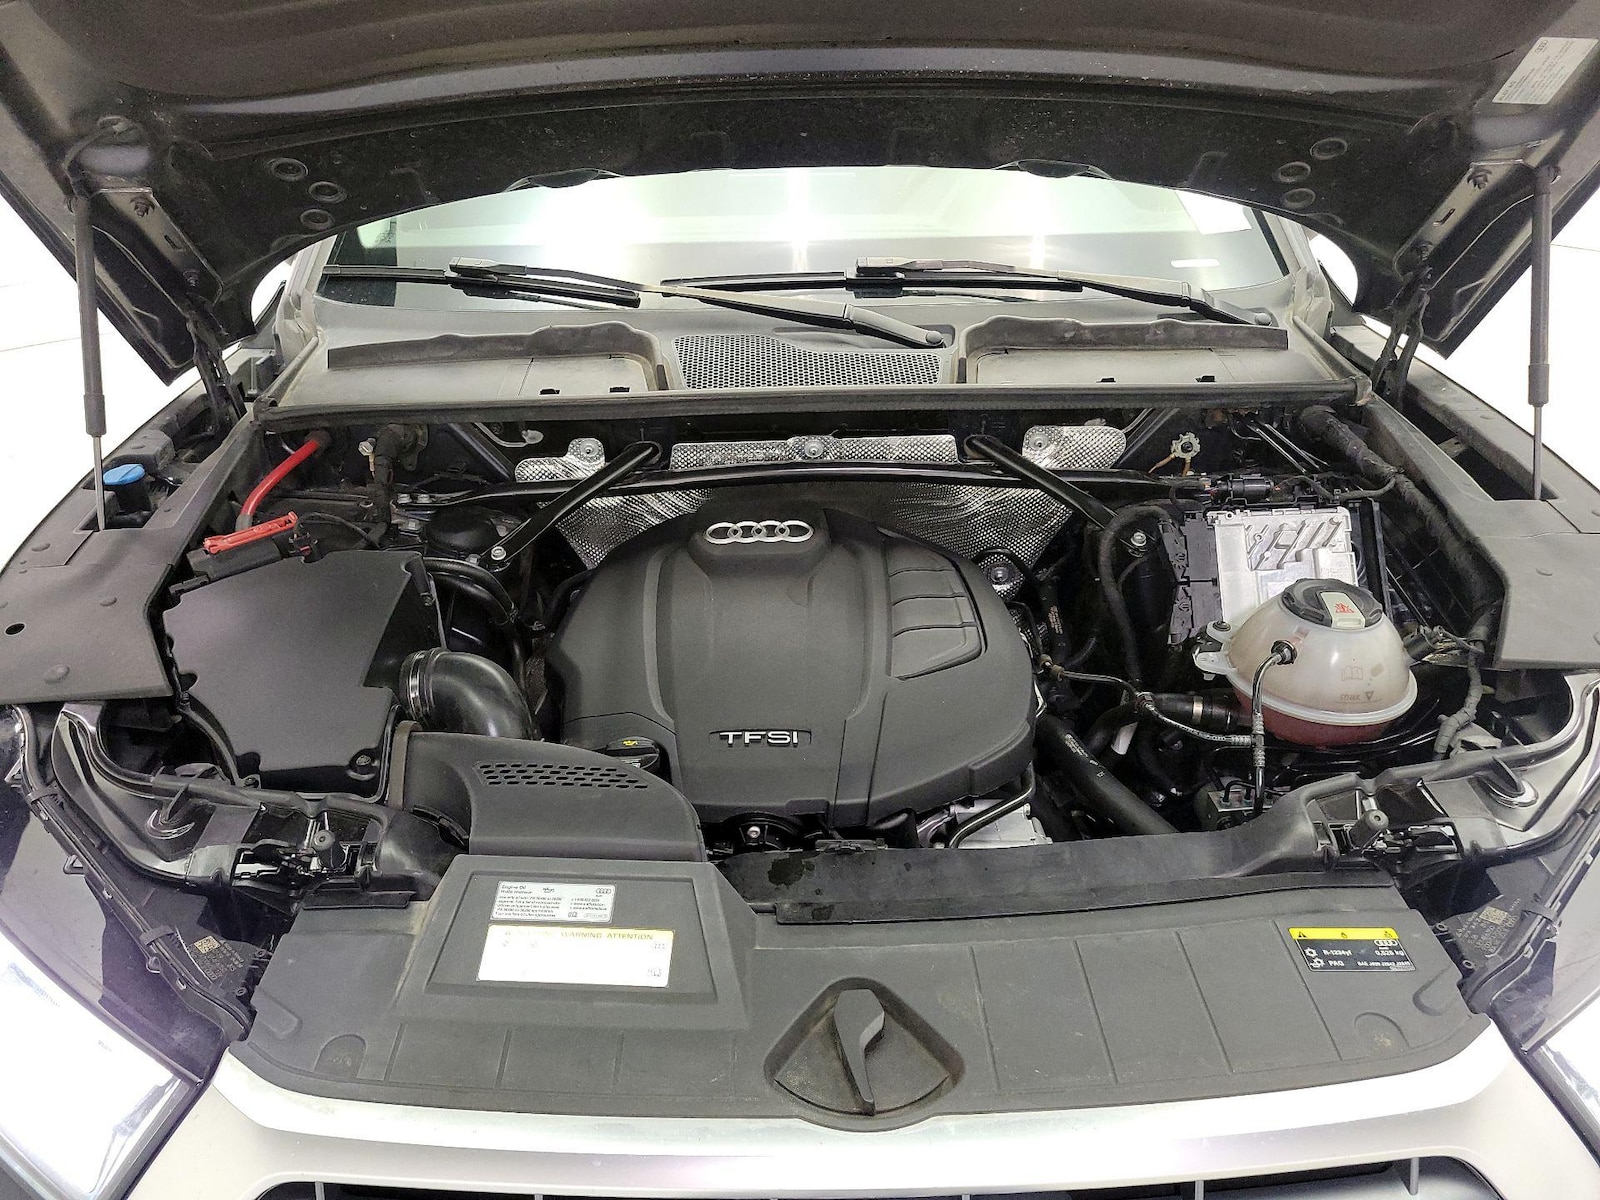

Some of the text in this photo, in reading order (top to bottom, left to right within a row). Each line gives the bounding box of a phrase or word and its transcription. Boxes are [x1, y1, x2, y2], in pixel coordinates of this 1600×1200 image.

[719, 731, 798, 745] TFSI
[561, 931, 602, 939] WARNING
[606, 932, 654, 941] ATTENTION
